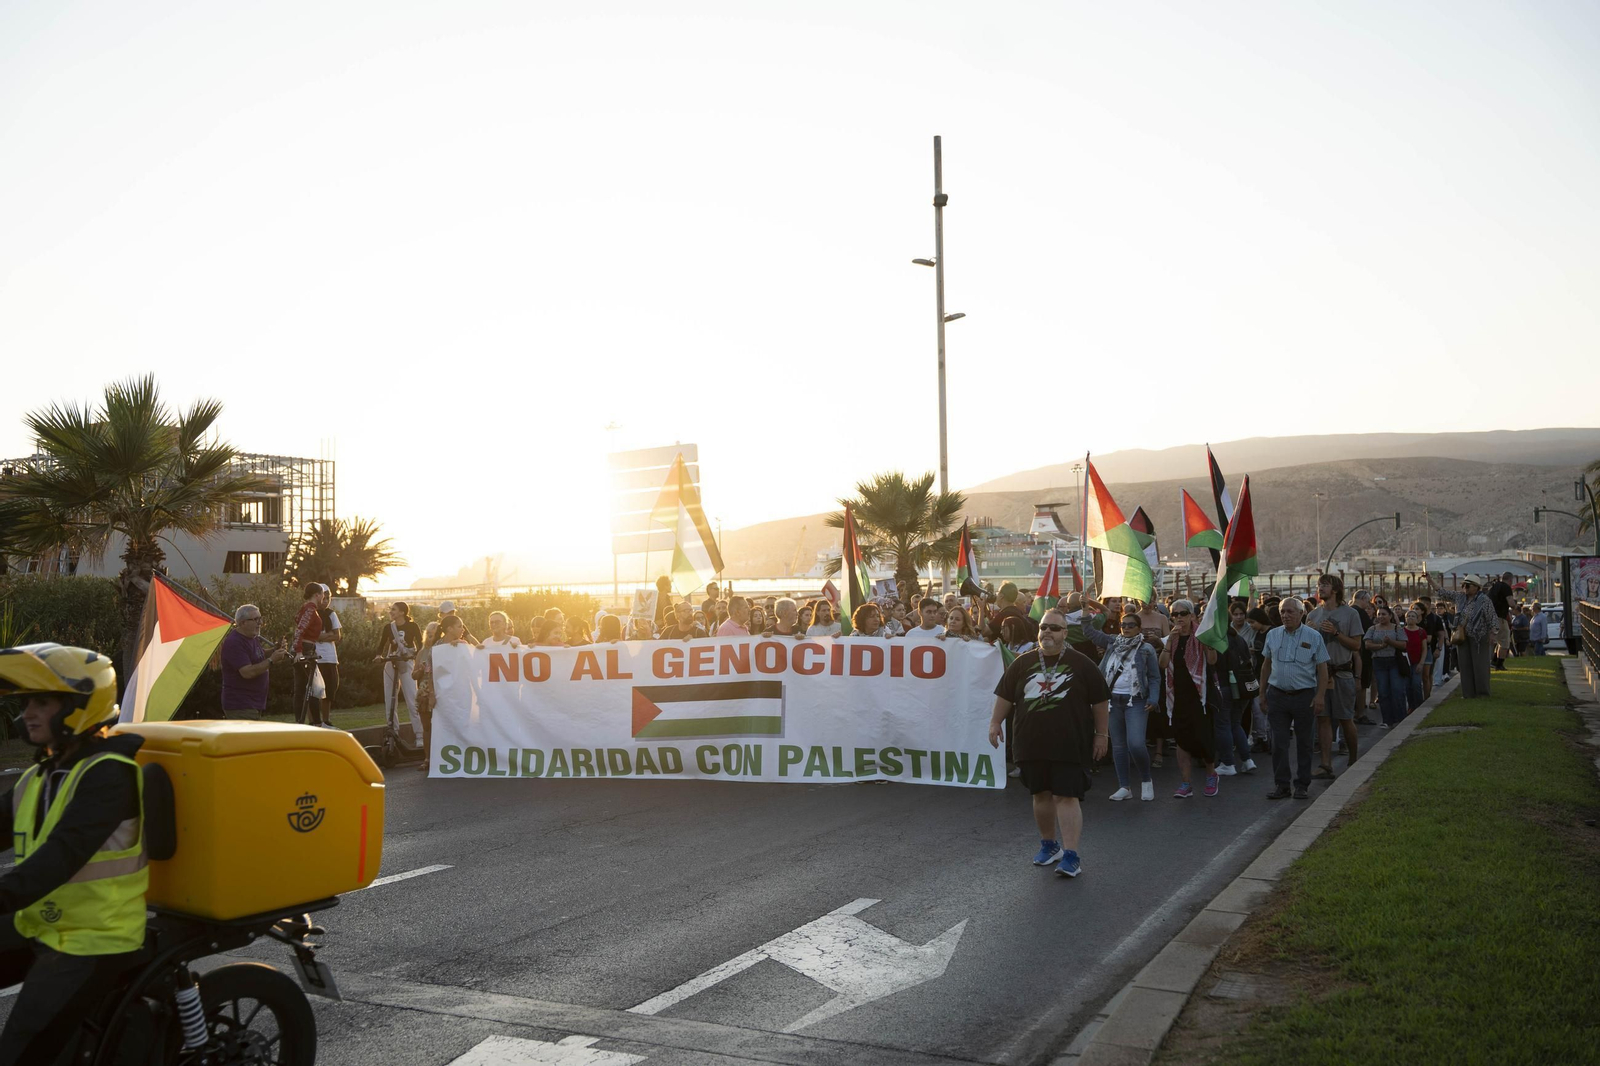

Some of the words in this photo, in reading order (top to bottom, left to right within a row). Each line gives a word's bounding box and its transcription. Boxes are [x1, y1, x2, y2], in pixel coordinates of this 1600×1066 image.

[488, 652, 552, 682] NO
[571, 649, 633, 681] AL
[652, 641, 946, 679] GENOCIDIO
[439, 744, 683, 778] SOLIDARIDAD
[695, 744, 763, 776] CON
[777, 745, 995, 787] PALESTINA
